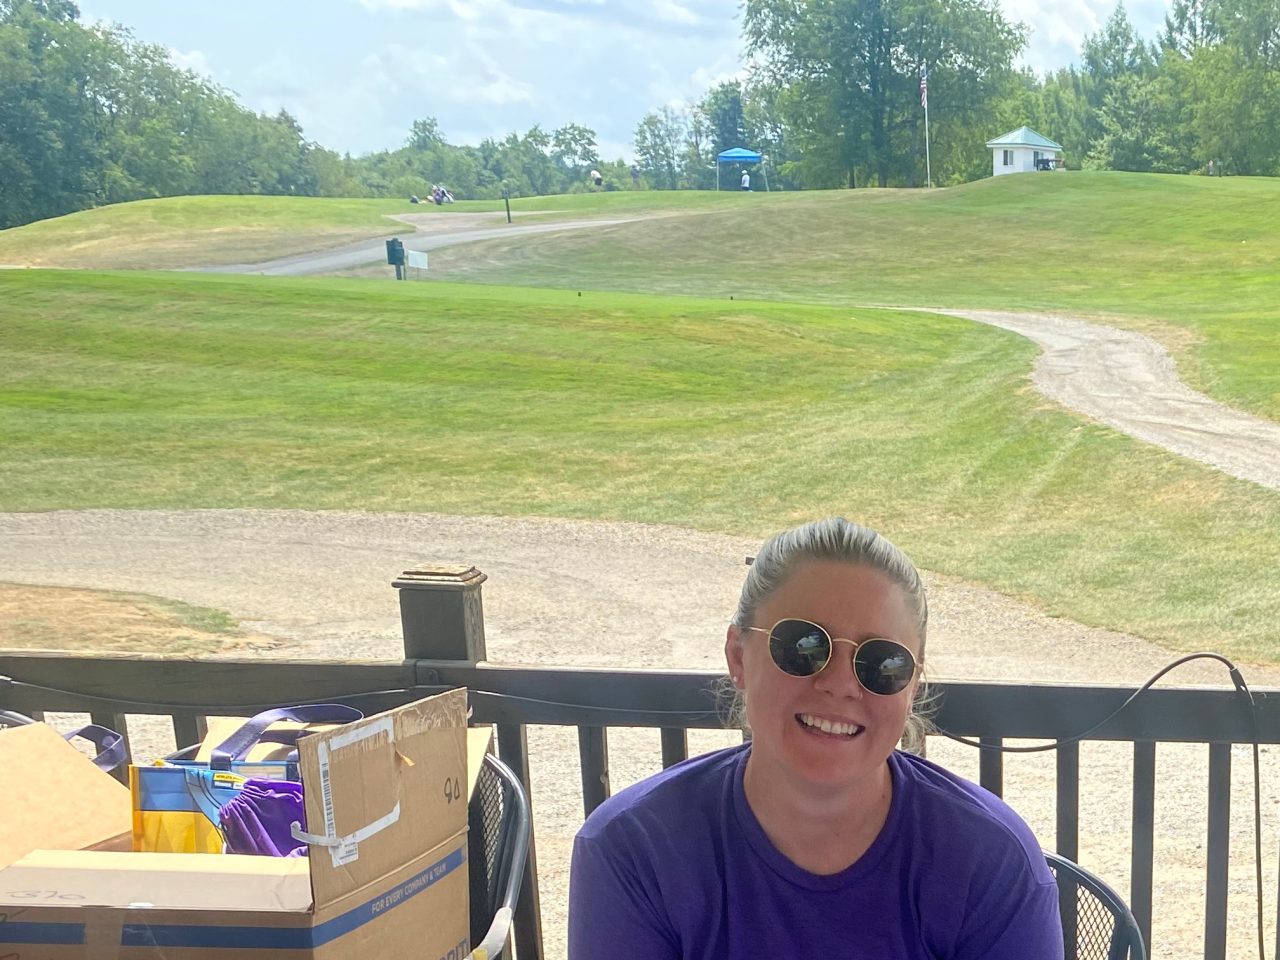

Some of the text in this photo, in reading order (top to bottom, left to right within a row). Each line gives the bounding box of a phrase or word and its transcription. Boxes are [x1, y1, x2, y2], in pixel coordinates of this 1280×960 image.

[372, 899, 384, 913] FOR
[386, 889, 403, 906] EVERY
[405, 873, 429, 895] COMPANY
[434, 864, 447, 876] TEAM
